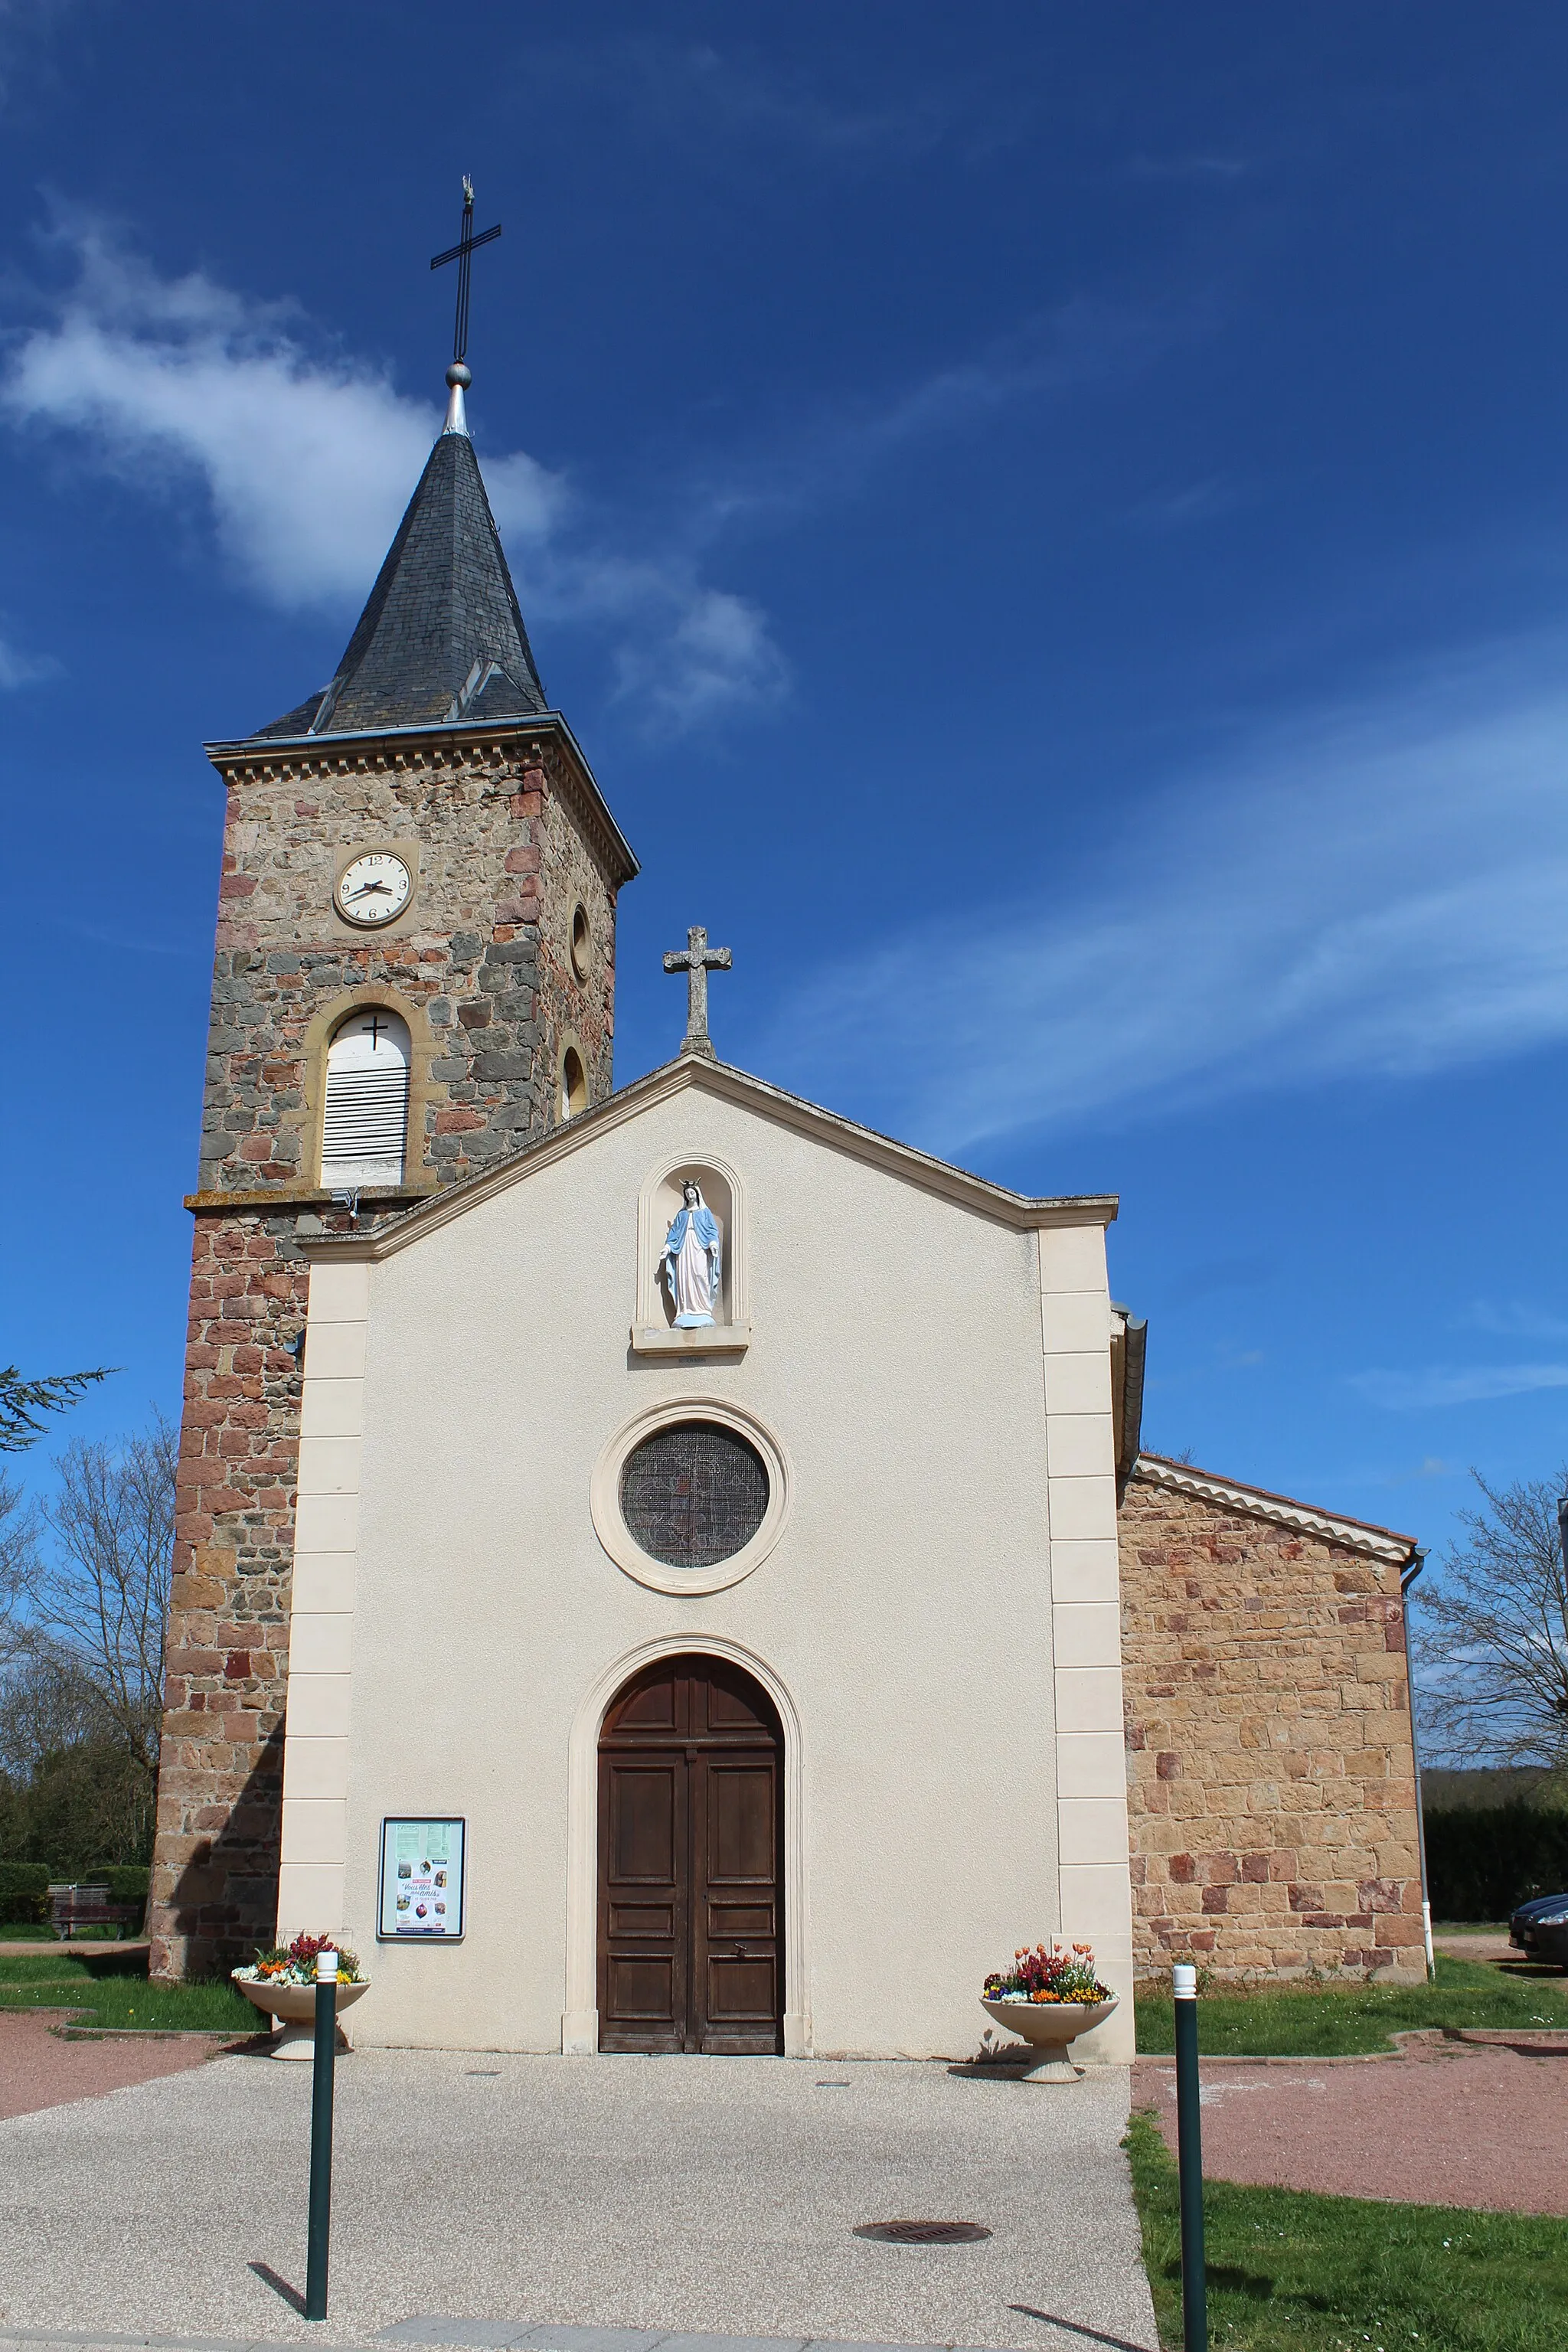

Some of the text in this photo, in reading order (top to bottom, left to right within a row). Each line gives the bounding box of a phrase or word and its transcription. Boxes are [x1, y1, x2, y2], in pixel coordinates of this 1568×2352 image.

[368, 855, 384, 866] 12
[341, 884, 350, 894] 9
[398, 880, 407, 890] 3
[368, 908, 377, 919] 6
